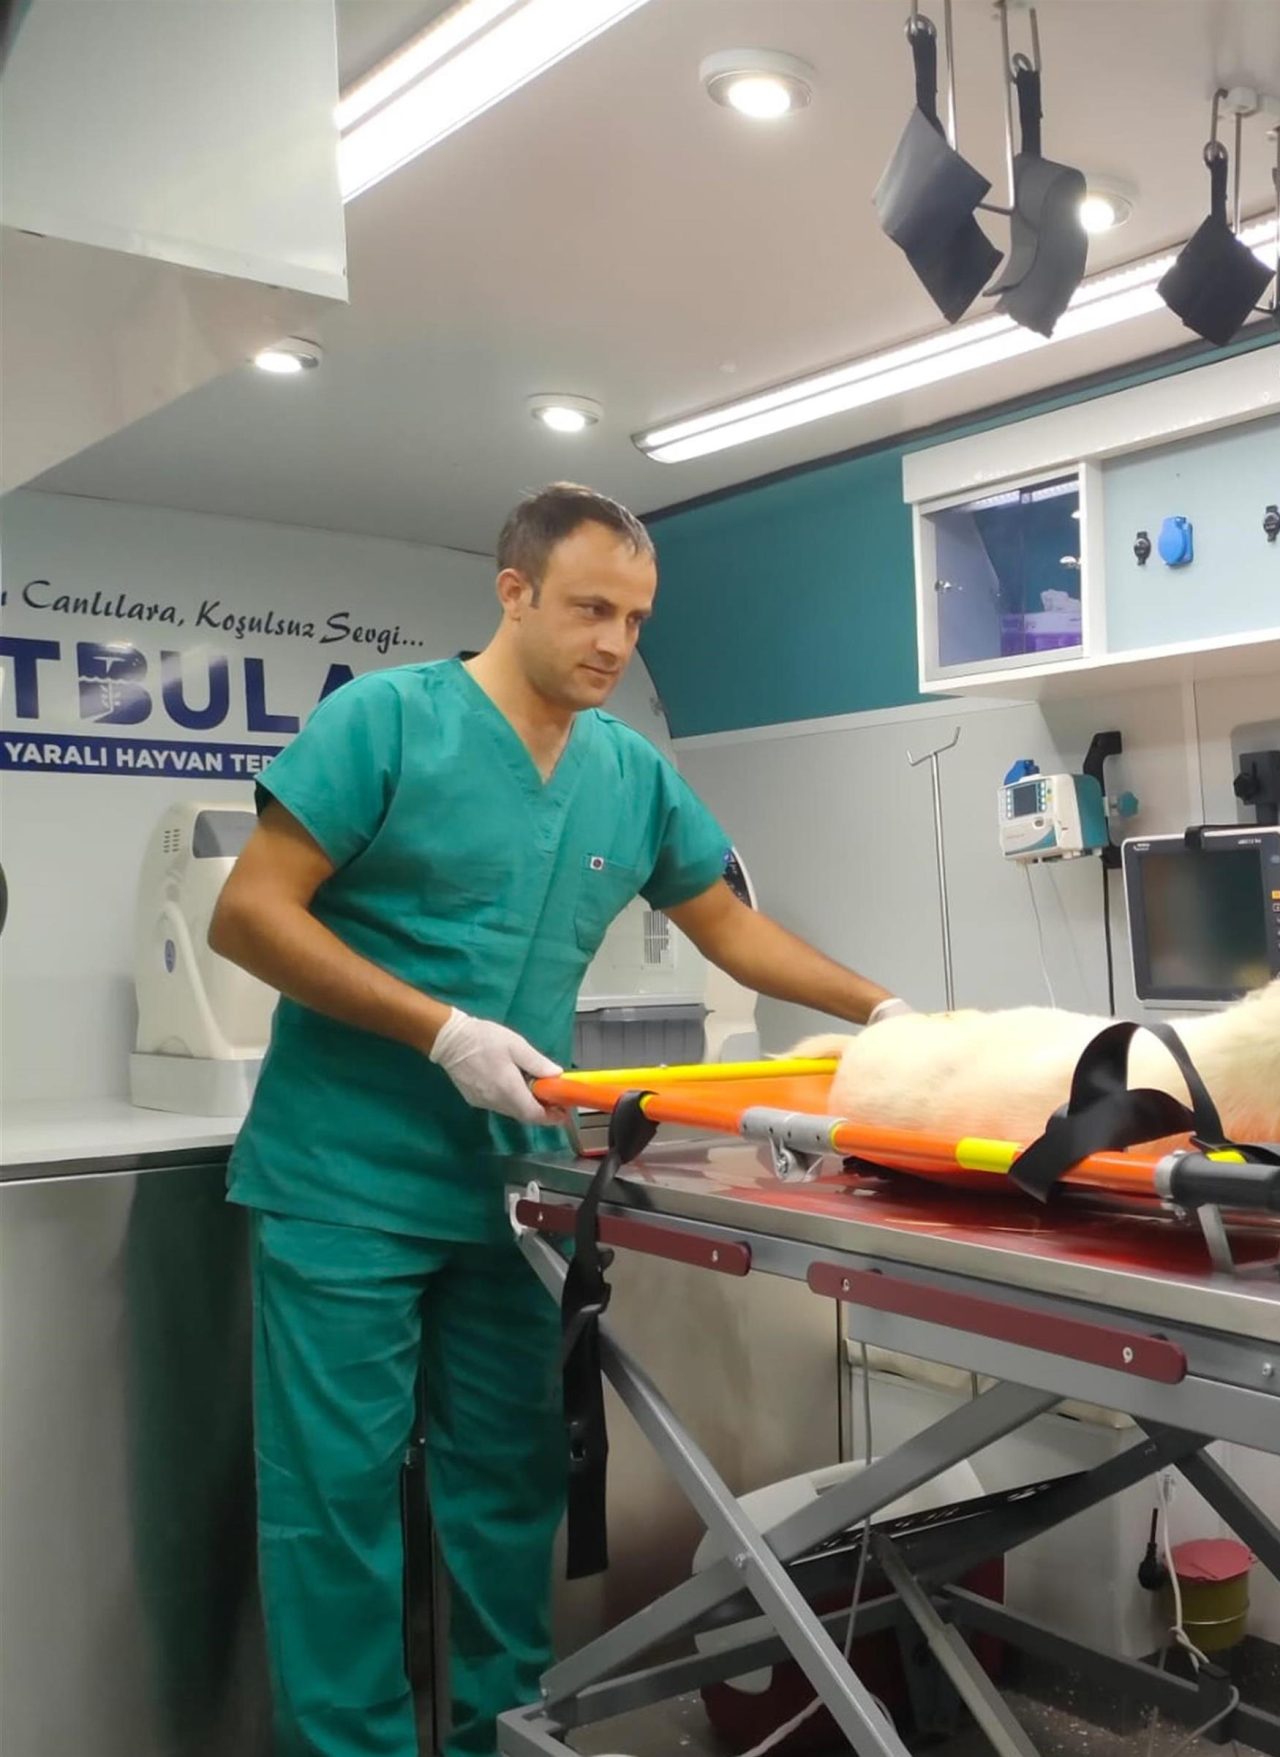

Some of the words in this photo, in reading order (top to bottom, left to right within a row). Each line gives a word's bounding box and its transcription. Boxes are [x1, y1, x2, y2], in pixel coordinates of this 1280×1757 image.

[22, 580, 185, 627] Canlılara,
[195, 600, 316, 639] Koşulsuz
[319, 612, 424, 654] Sevgi...
[4, 742, 108, 767] YARALI
[116, 748, 223, 772] HAYVAN
